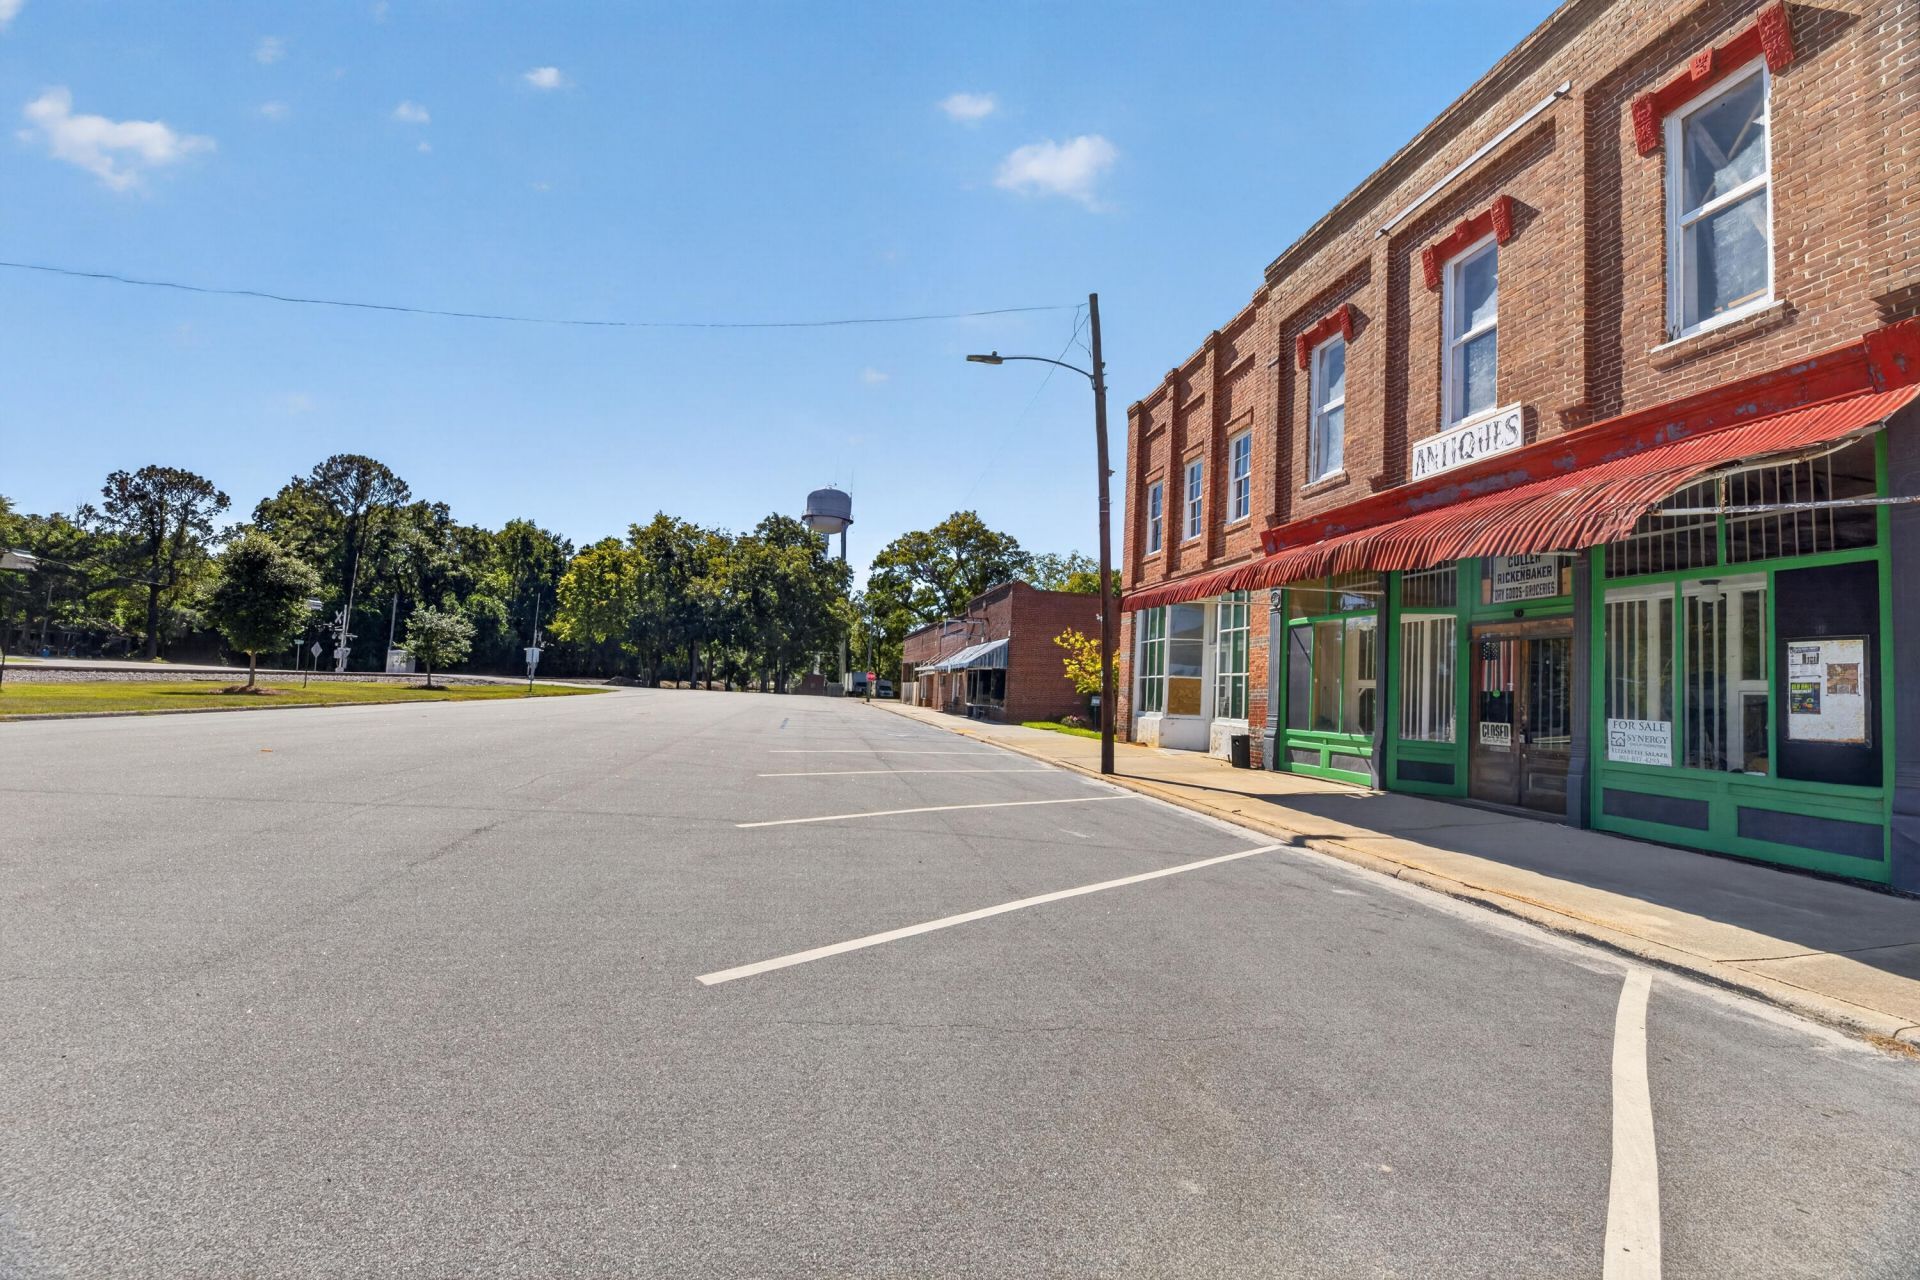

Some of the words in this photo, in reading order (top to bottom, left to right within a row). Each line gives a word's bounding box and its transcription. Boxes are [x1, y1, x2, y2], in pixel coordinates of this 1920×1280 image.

[1415, 414, 1519, 477] ANTIQUES
[1497, 566, 1553, 584] RICKENBAKER
[1494, 588, 1505, 601] DRY
[1613, 720, 1636, 730] FOR
[1639, 722, 1666, 732] SALE
[1626, 734, 1669, 744] SYNERGY
